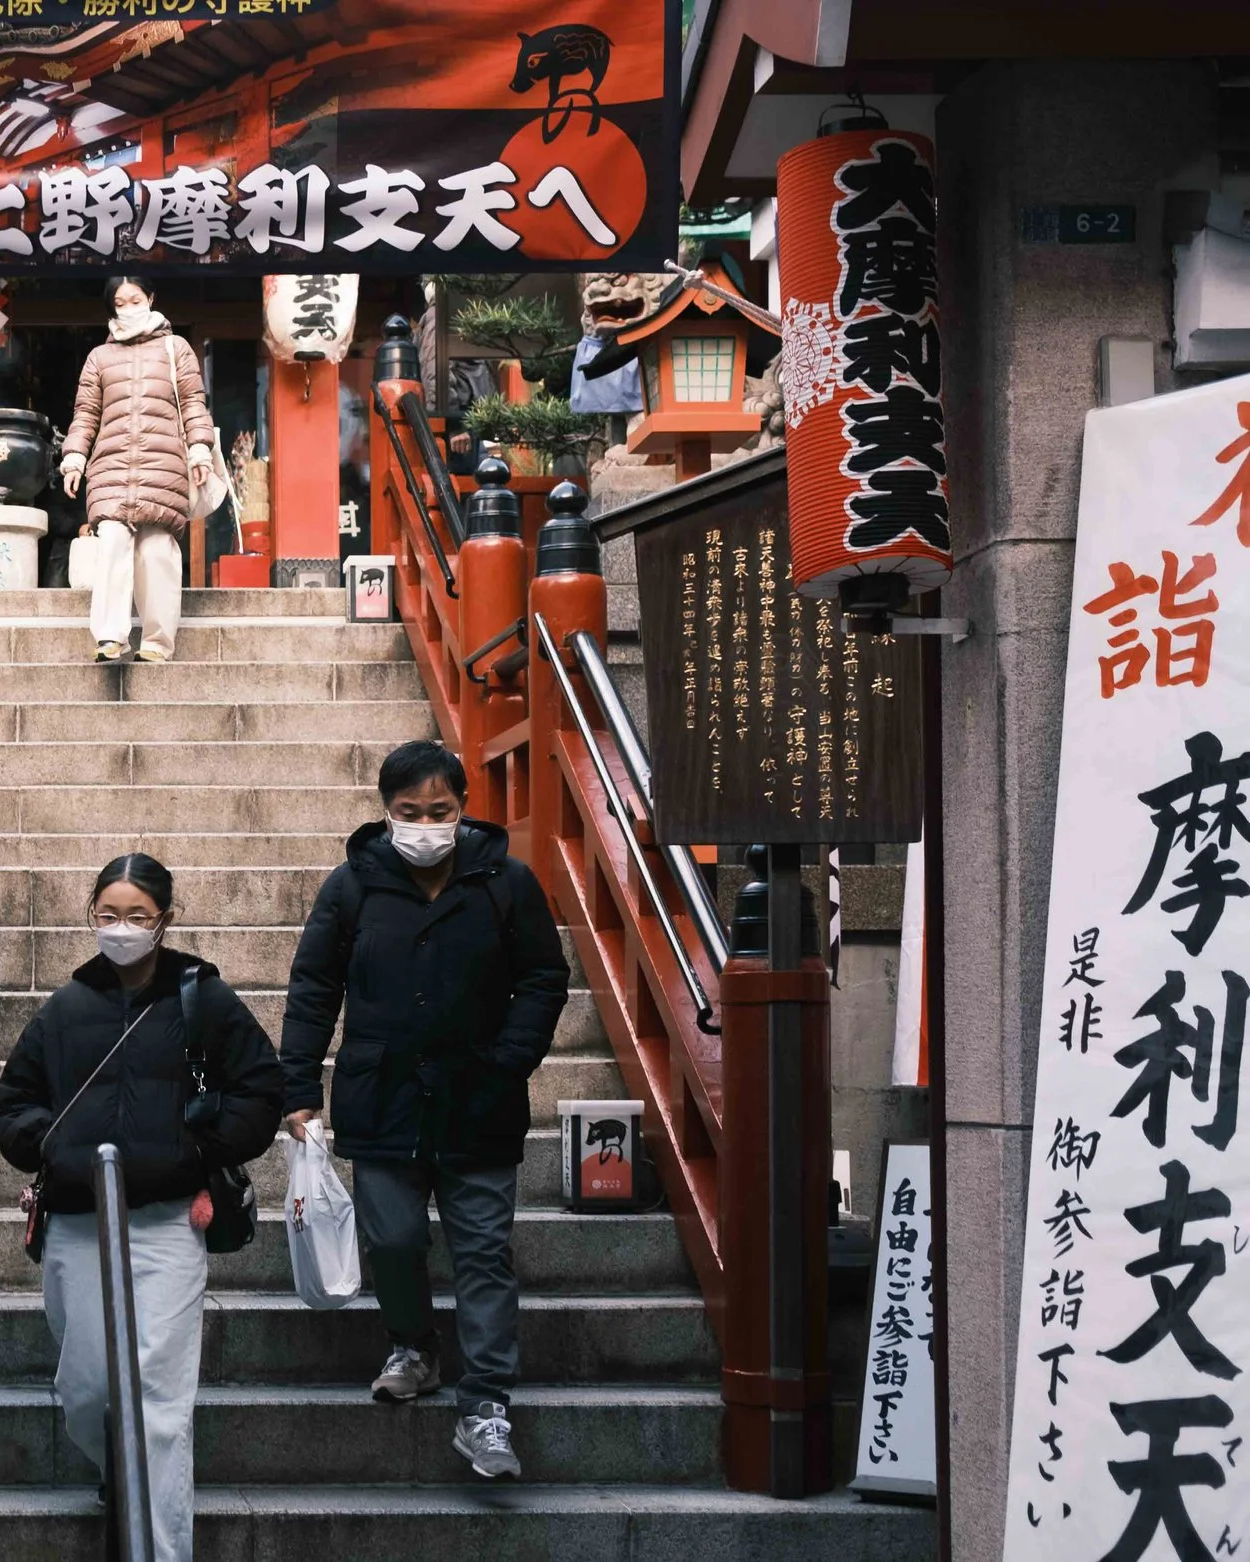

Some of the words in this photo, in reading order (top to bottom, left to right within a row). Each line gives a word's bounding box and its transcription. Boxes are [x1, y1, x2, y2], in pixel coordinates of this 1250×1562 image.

[834, 139, 950, 552] 大摩利支天
[1076, 213, 1120, 233] 6-2
[1059, 928, 1104, 1053] 是非
[1098, 731, 1250, 1562] 摩利支天
[869, 1177, 918, 1465] 自由にご参詣下さい
[1027, 1117, 1102, 1529] 御参詣下さい
